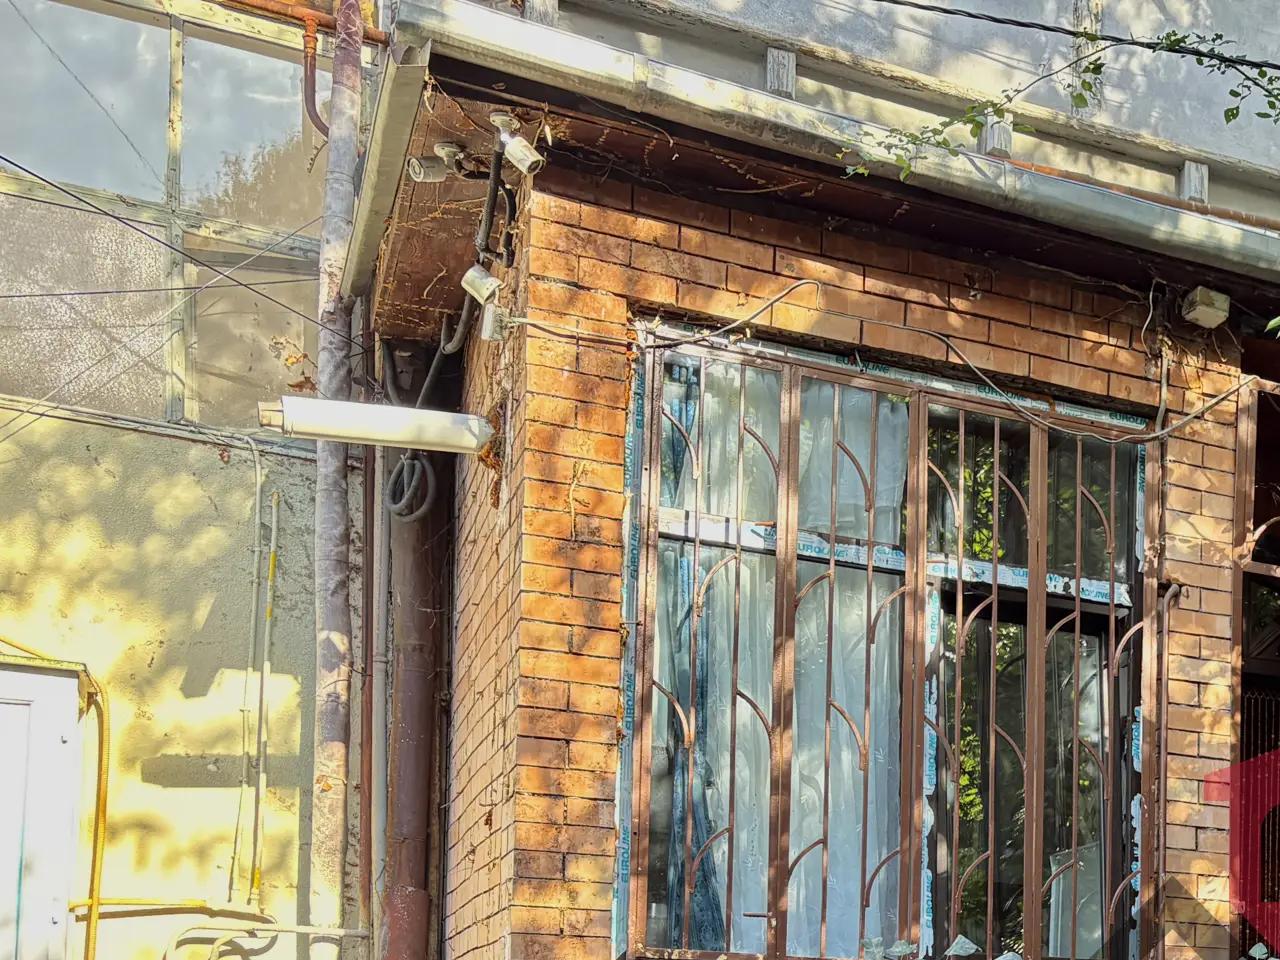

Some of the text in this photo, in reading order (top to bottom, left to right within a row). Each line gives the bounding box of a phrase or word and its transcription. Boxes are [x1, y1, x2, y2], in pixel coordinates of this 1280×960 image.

[835, 356, 890, 374] EULINE
[634, 371, 645, 430] EUROLINE
[1109, 411, 1148, 426] EUROLIN
[629, 522, 640, 580] EUROLINE
[1133, 709, 1141, 760] EROLINE
[621, 825, 631, 883] EUROLINE
